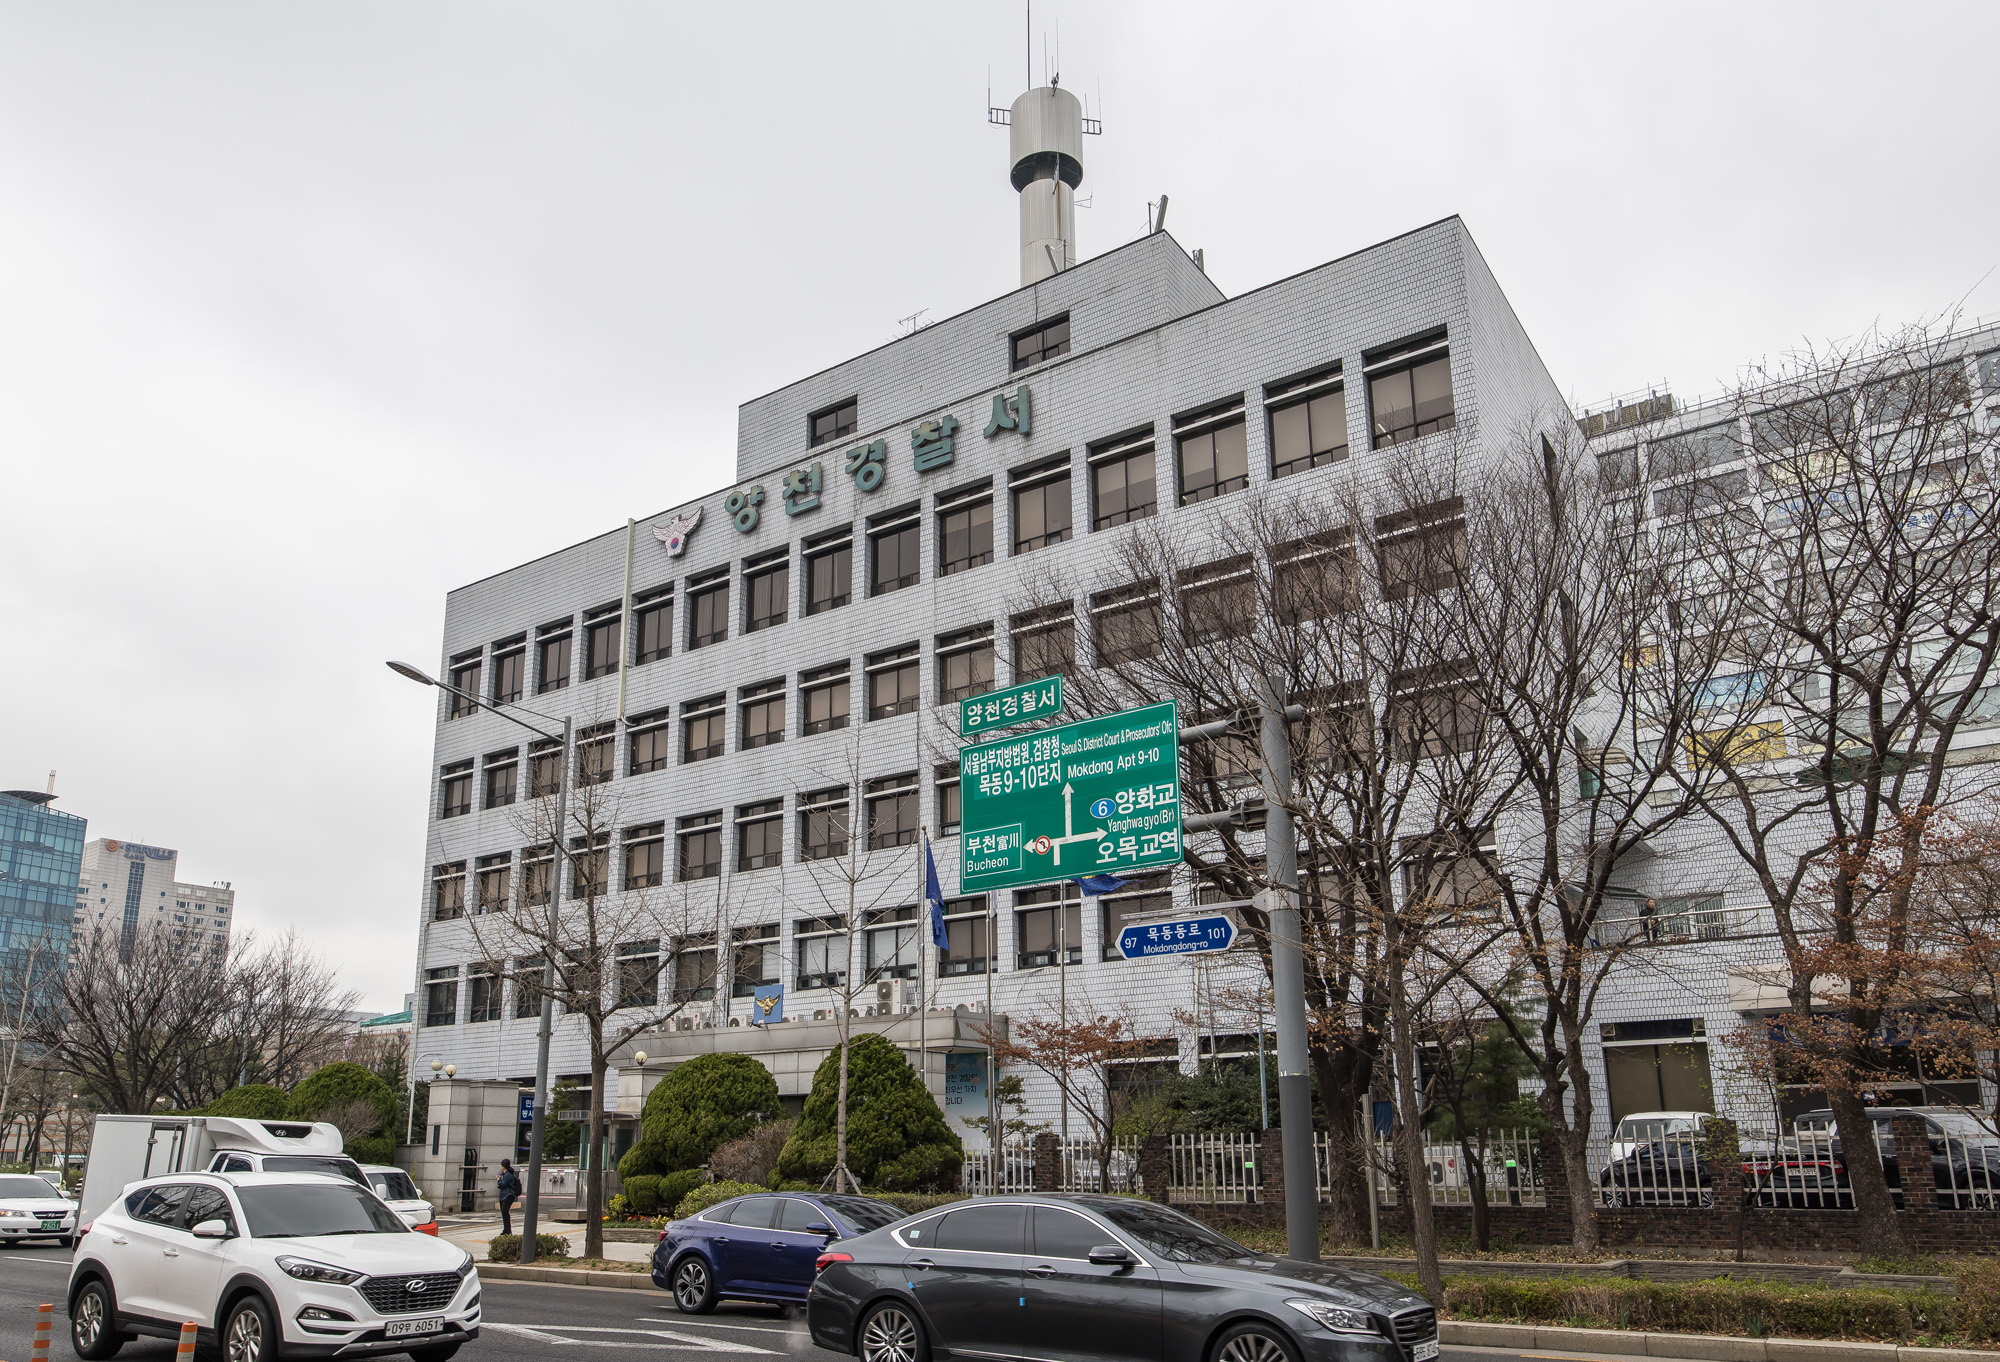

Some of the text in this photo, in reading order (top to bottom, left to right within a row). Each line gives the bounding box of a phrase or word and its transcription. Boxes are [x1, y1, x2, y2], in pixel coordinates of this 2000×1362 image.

[724, 384, 1031, 533] 양천경찰서
[967, 685, 1055, 726] 양천경찰서
[1061, 740, 1077, 756] Seoul
[1083, 736, 1103, 751] District
[1103, 731, 1120, 747] Court
[1120, 730, 1126, 744] &
[1161, 720, 1173, 735] Ofc
[1067, 747, 1160, 779] Mokdong Apt 9-10
[1098, 801, 1108, 816] 6
[1115, 783, 1177, 815] 양화교
[1096, 827, 1179, 864] 오목교역
[967, 857, 1009, 872] Bucheon
[1125, 923, 1226, 949] 97 목동동로 101
[1143, 940, 1209, 955] Mokdongdong-ro
[391, 1320, 439, 1335] 09무 6051
